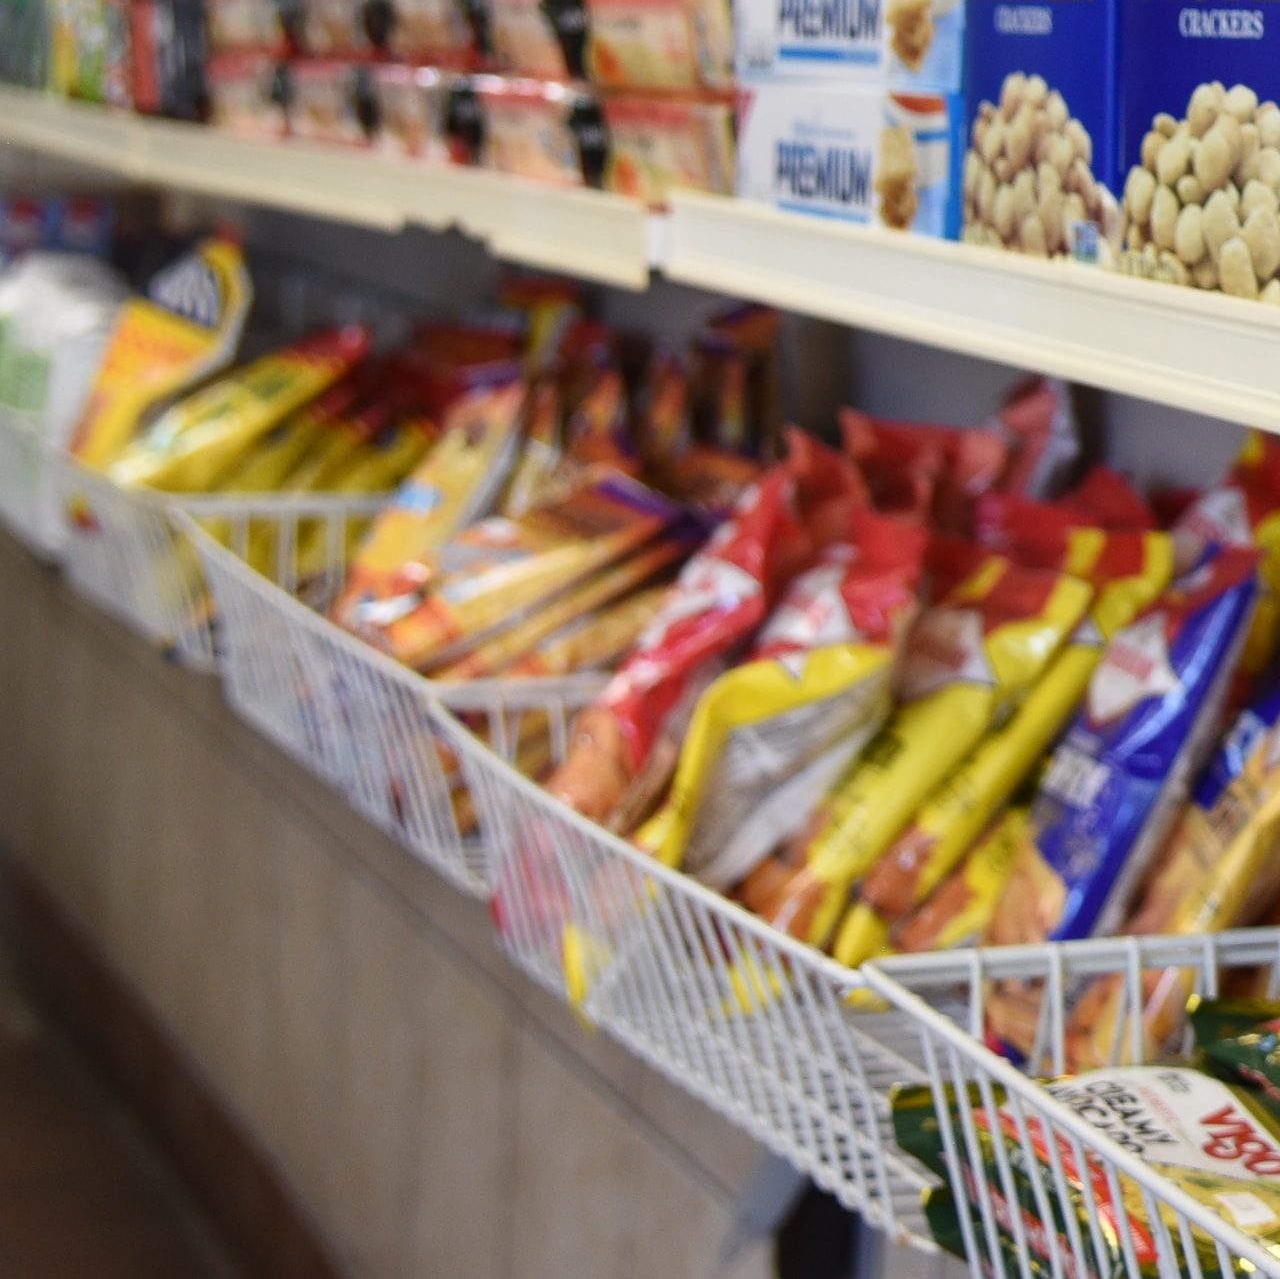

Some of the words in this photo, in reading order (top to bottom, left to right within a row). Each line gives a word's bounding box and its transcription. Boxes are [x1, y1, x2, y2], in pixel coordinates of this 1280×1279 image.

[1179, 8, 1265, 39] CRACKERS
[776, 142, 871, 206] PREMIUM
[1085, 1079, 1178, 1145] CREAMY
